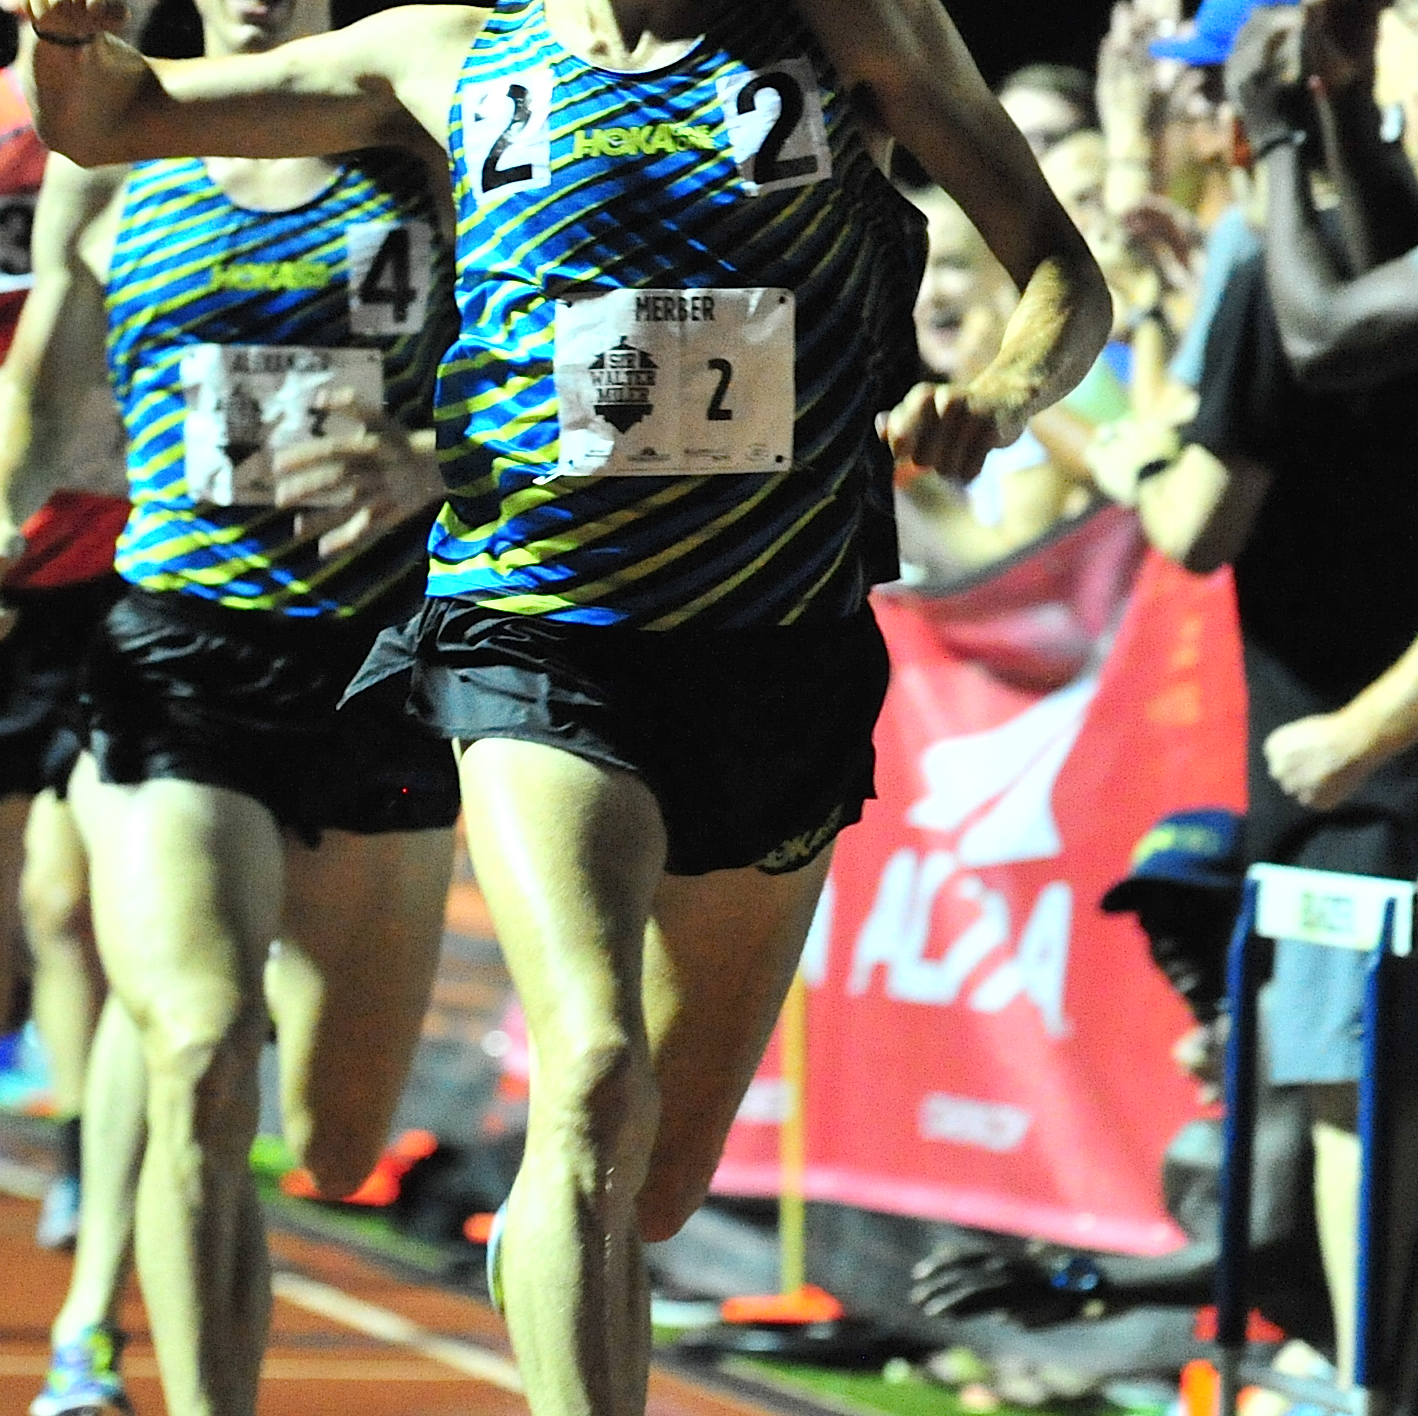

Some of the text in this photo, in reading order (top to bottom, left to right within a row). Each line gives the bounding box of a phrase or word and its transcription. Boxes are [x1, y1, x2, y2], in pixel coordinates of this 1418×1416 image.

[475, 83, 533, 192] 2
[737, 72, 819, 182] 2
[359, 228, 416, 323] 4
[634, 295, 715, 322] MERBER
[706, 358, 733, 421] 2
